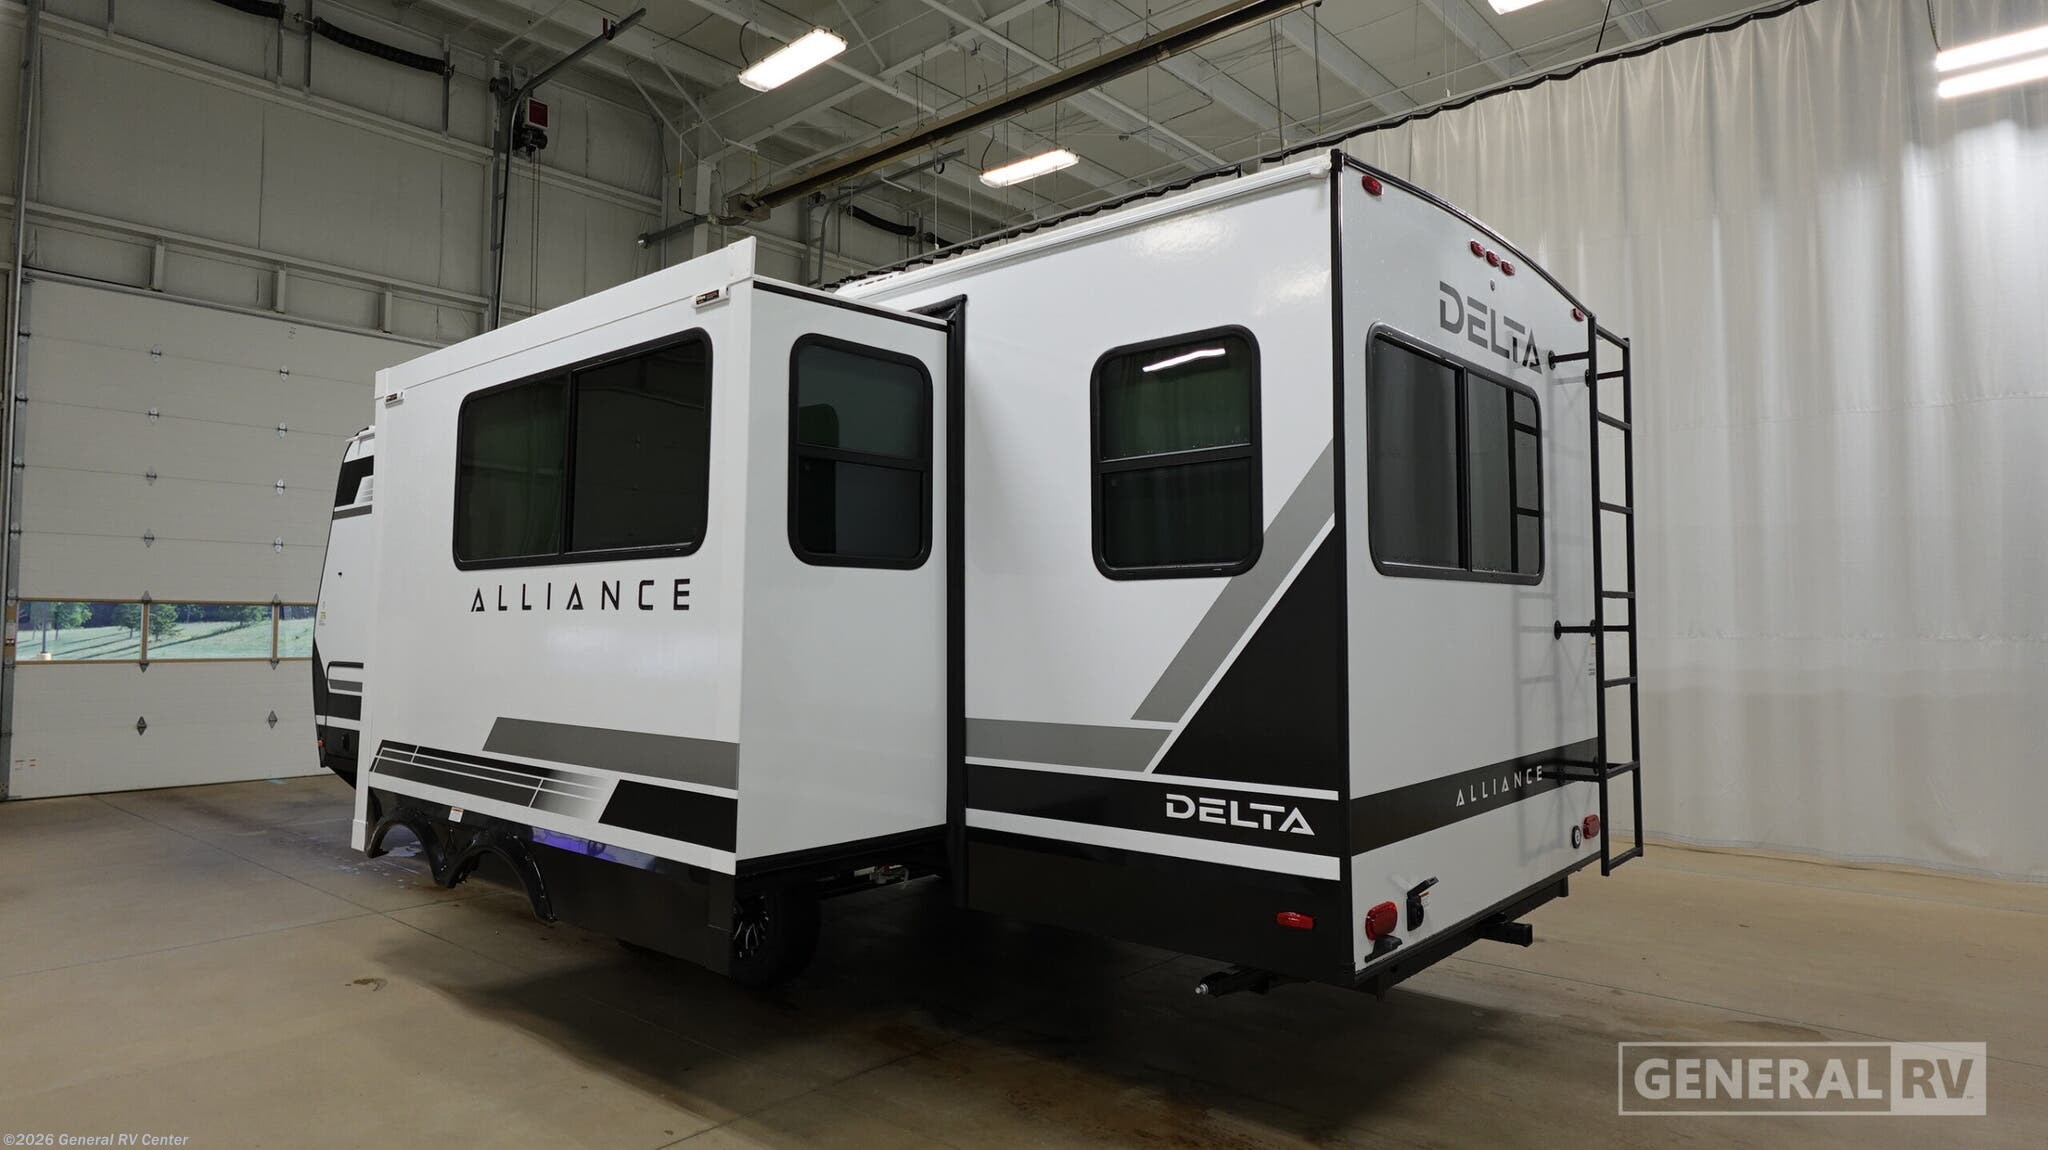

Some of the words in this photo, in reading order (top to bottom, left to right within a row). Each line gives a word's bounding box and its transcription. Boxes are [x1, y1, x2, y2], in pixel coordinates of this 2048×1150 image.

[1440, 281, 1542, 374] DELTA
[471, 579, 690, 612] ALLIANCE
[1456, 765, 1543, 807] ALLIANCE
[1166, 793, 1315, 836] DELTA
